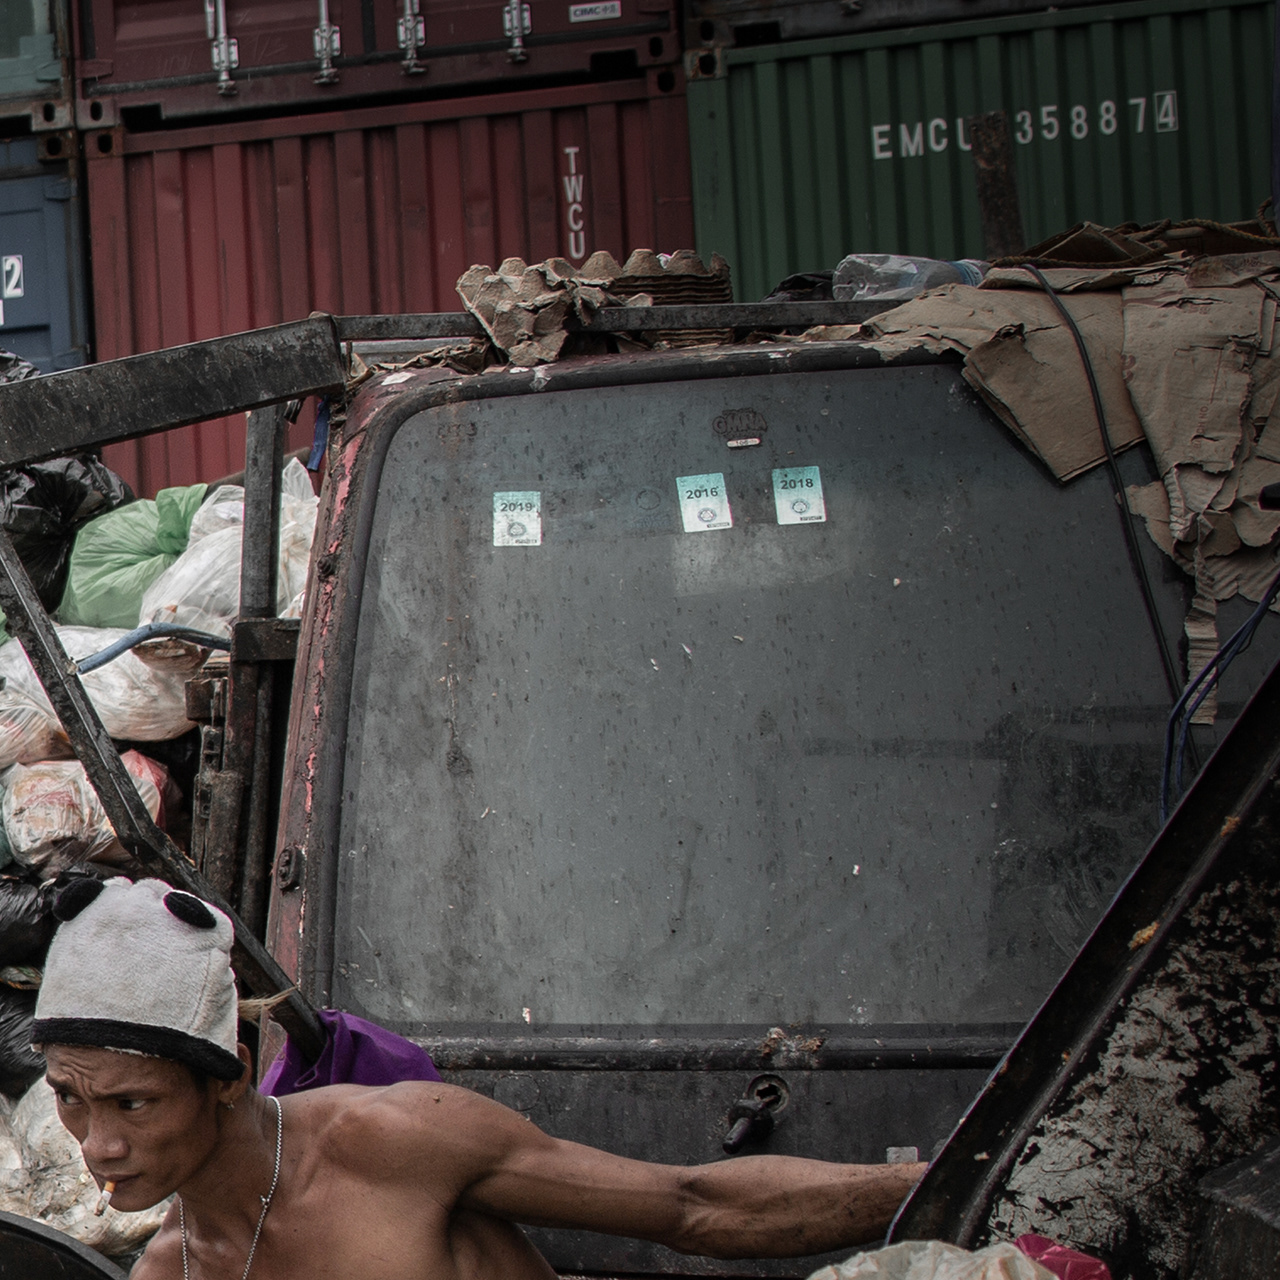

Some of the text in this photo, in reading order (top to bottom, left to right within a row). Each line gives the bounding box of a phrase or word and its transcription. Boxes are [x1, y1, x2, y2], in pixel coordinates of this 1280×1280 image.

[780, 478, 814, 490] 2018
[685, 487, 719, 500] 2016
[500, 502, 533, 512] 2019
